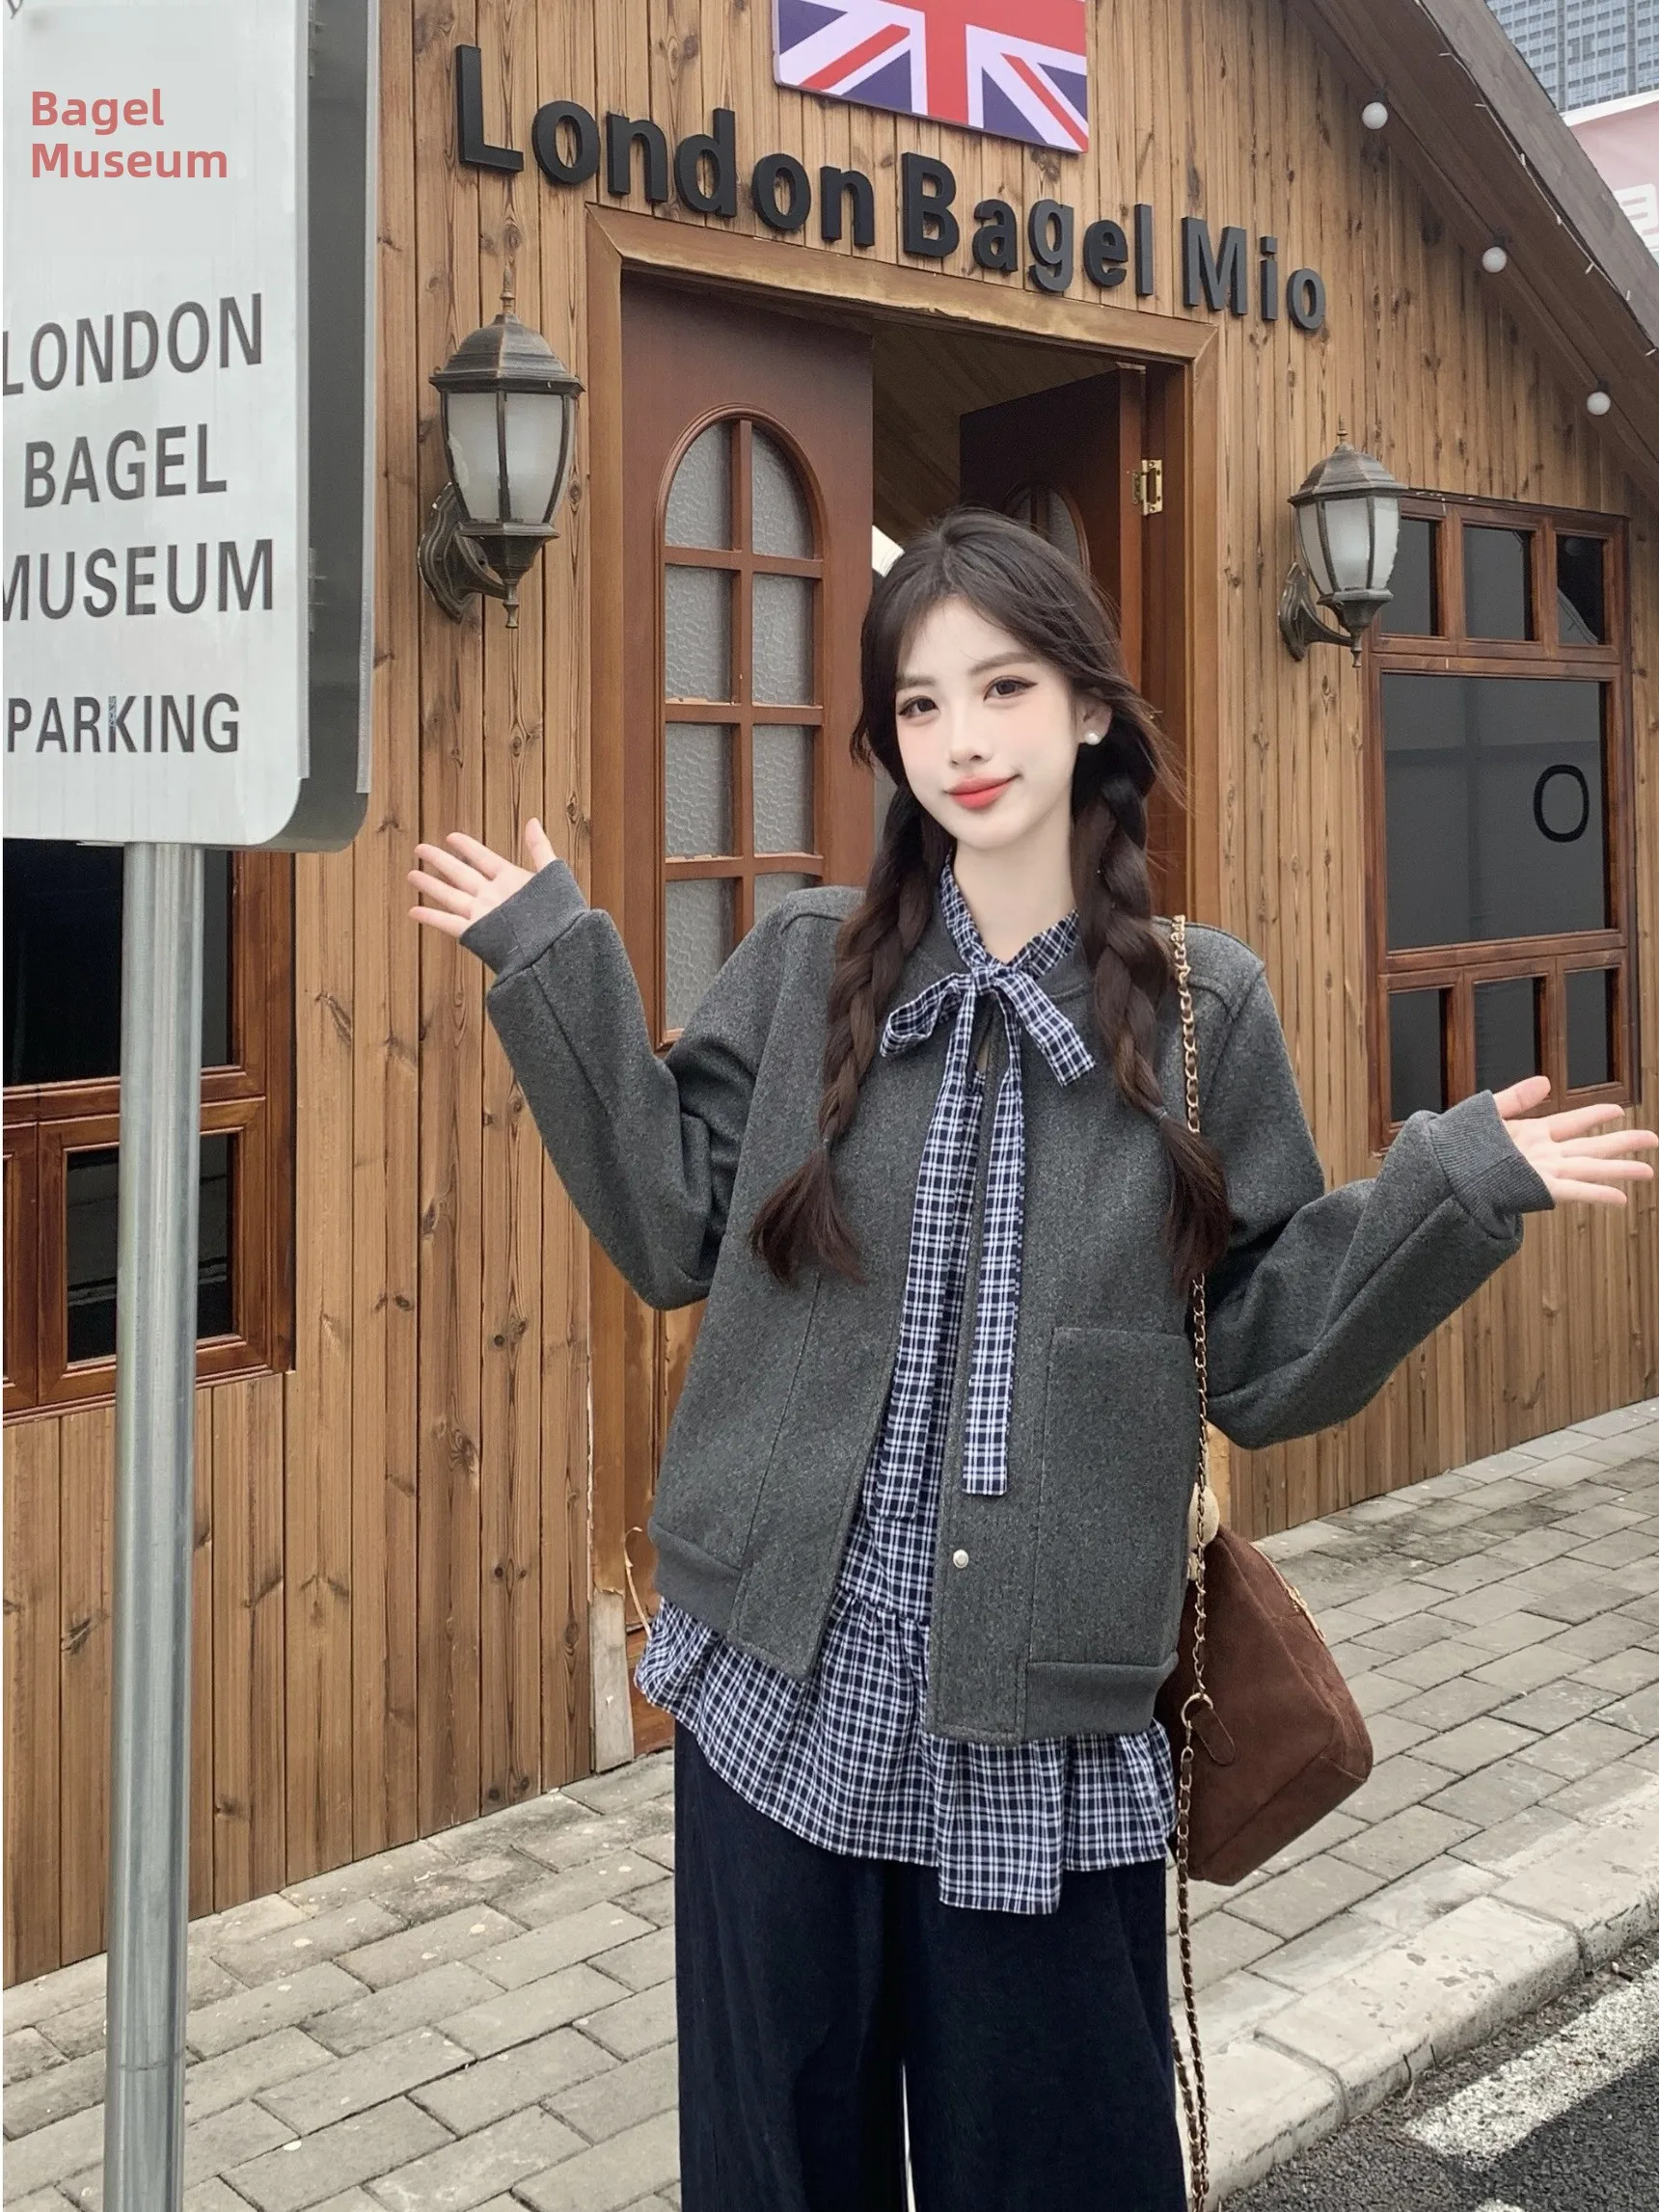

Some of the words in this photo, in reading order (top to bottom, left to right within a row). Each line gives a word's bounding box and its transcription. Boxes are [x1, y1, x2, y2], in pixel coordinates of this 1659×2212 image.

[455, 44, 875, 248] London
[901, 151, 1155, 297] Bagel
[1182, 215, 1326, 330] Mio
[2, 292, 262, 396] LONDON
[24, 423, 228, 508] BAGEL
[6, 692, 240, 754] PARKING
